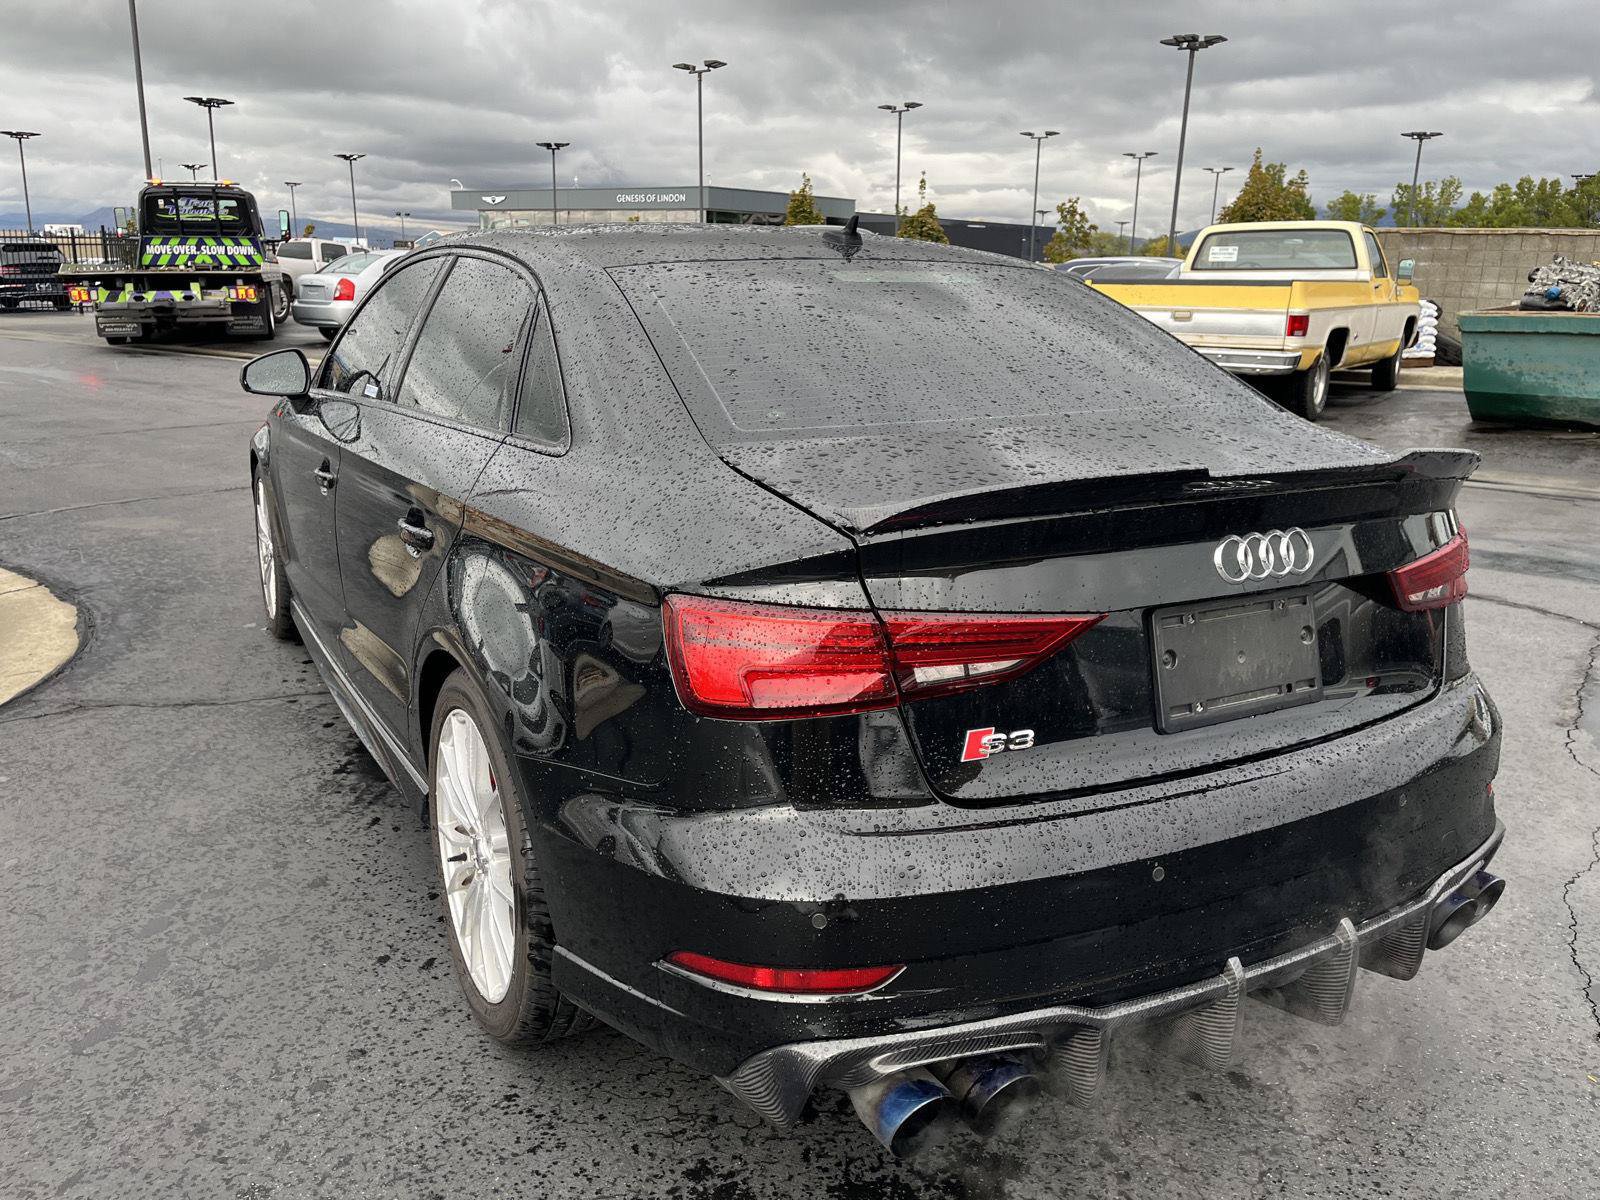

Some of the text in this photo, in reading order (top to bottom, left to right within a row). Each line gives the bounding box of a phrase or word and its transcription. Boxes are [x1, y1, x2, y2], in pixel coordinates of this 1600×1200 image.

[616, 193, 686, 202] GENESIS OF LINDON
[146, 245, 172, 255] MOVE
[201, 245, 225, 255] SLOW
[979, 729, 1035, 754] S3
